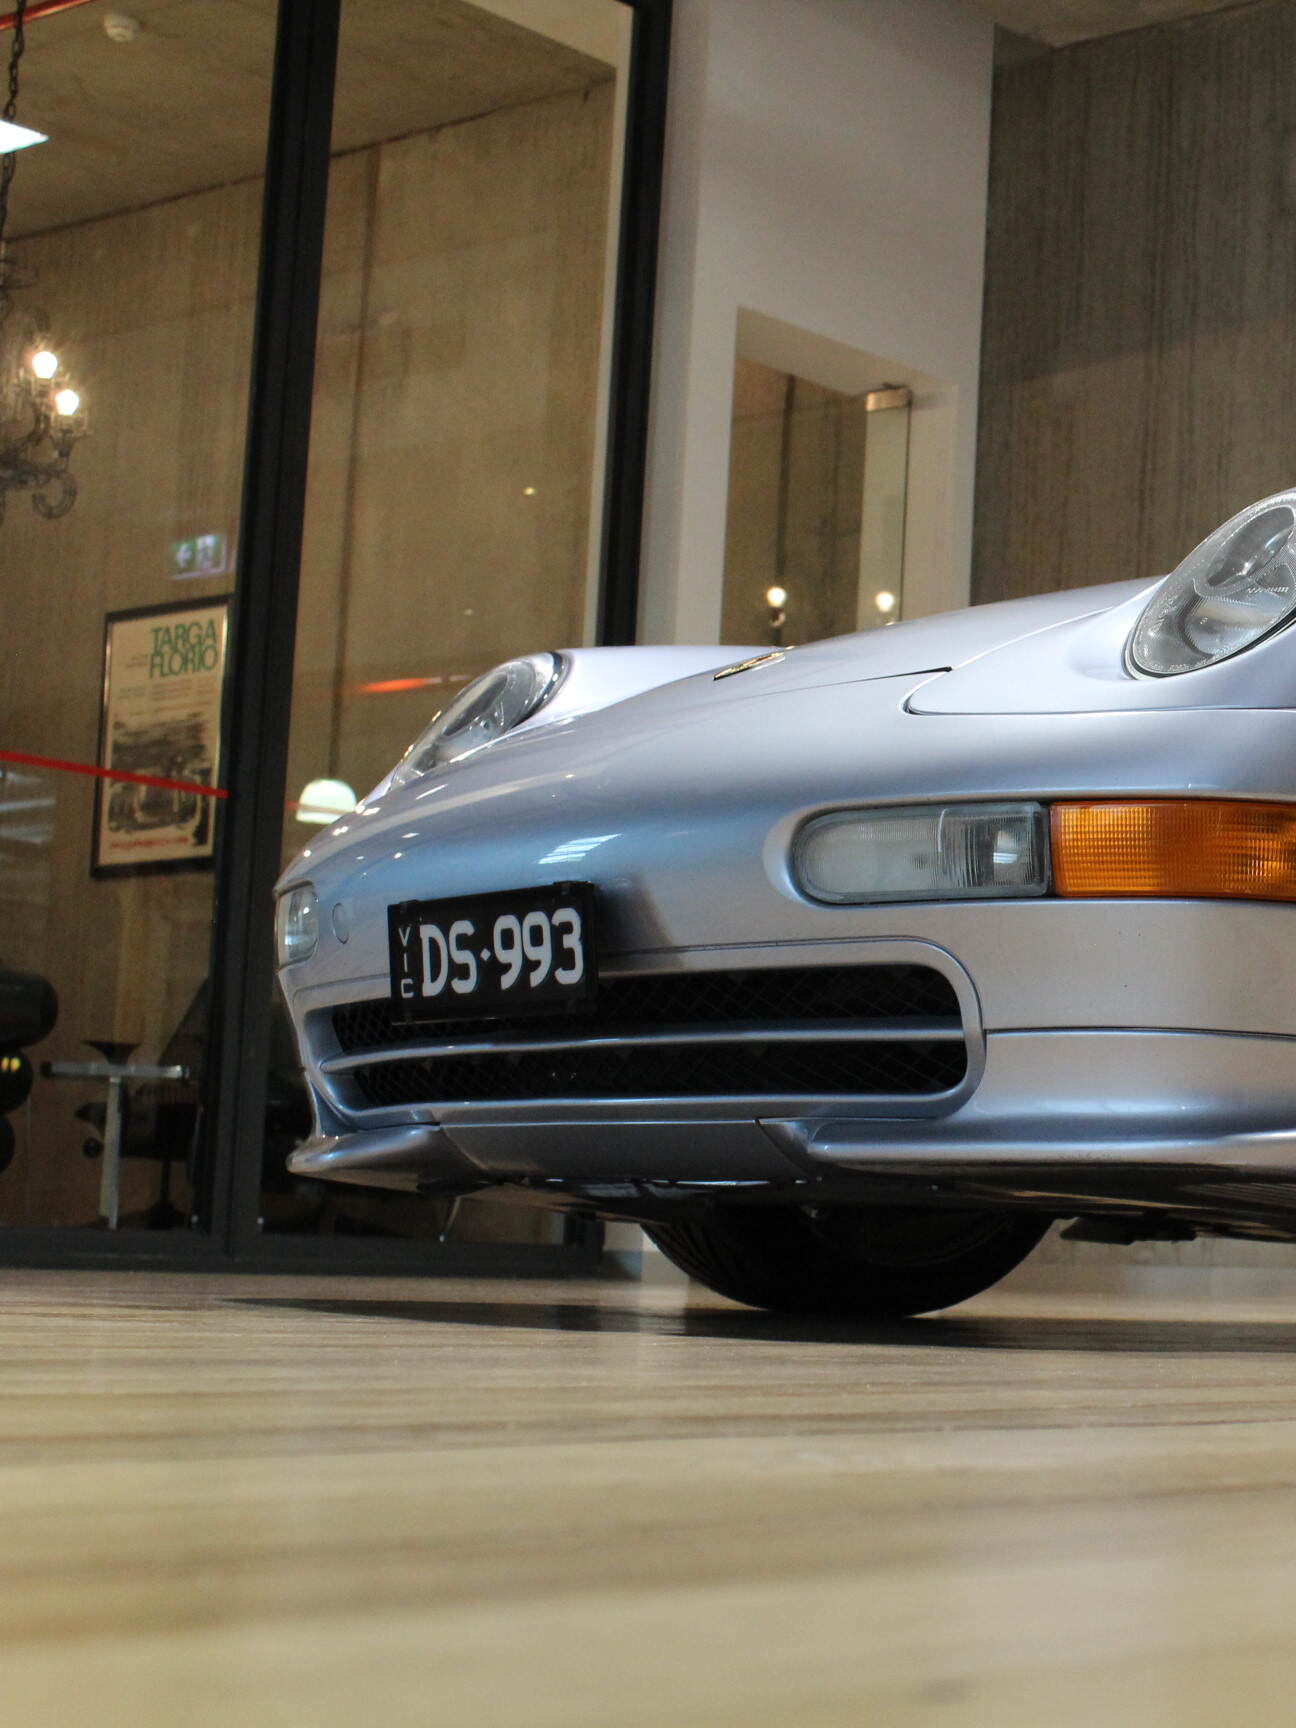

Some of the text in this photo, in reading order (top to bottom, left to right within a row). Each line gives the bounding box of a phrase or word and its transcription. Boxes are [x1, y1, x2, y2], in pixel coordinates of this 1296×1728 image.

[150, 618, 217, 656] TARGA
[148, 646, 218, 679] FLORIO
[398, 926, 414, 998] VIC
